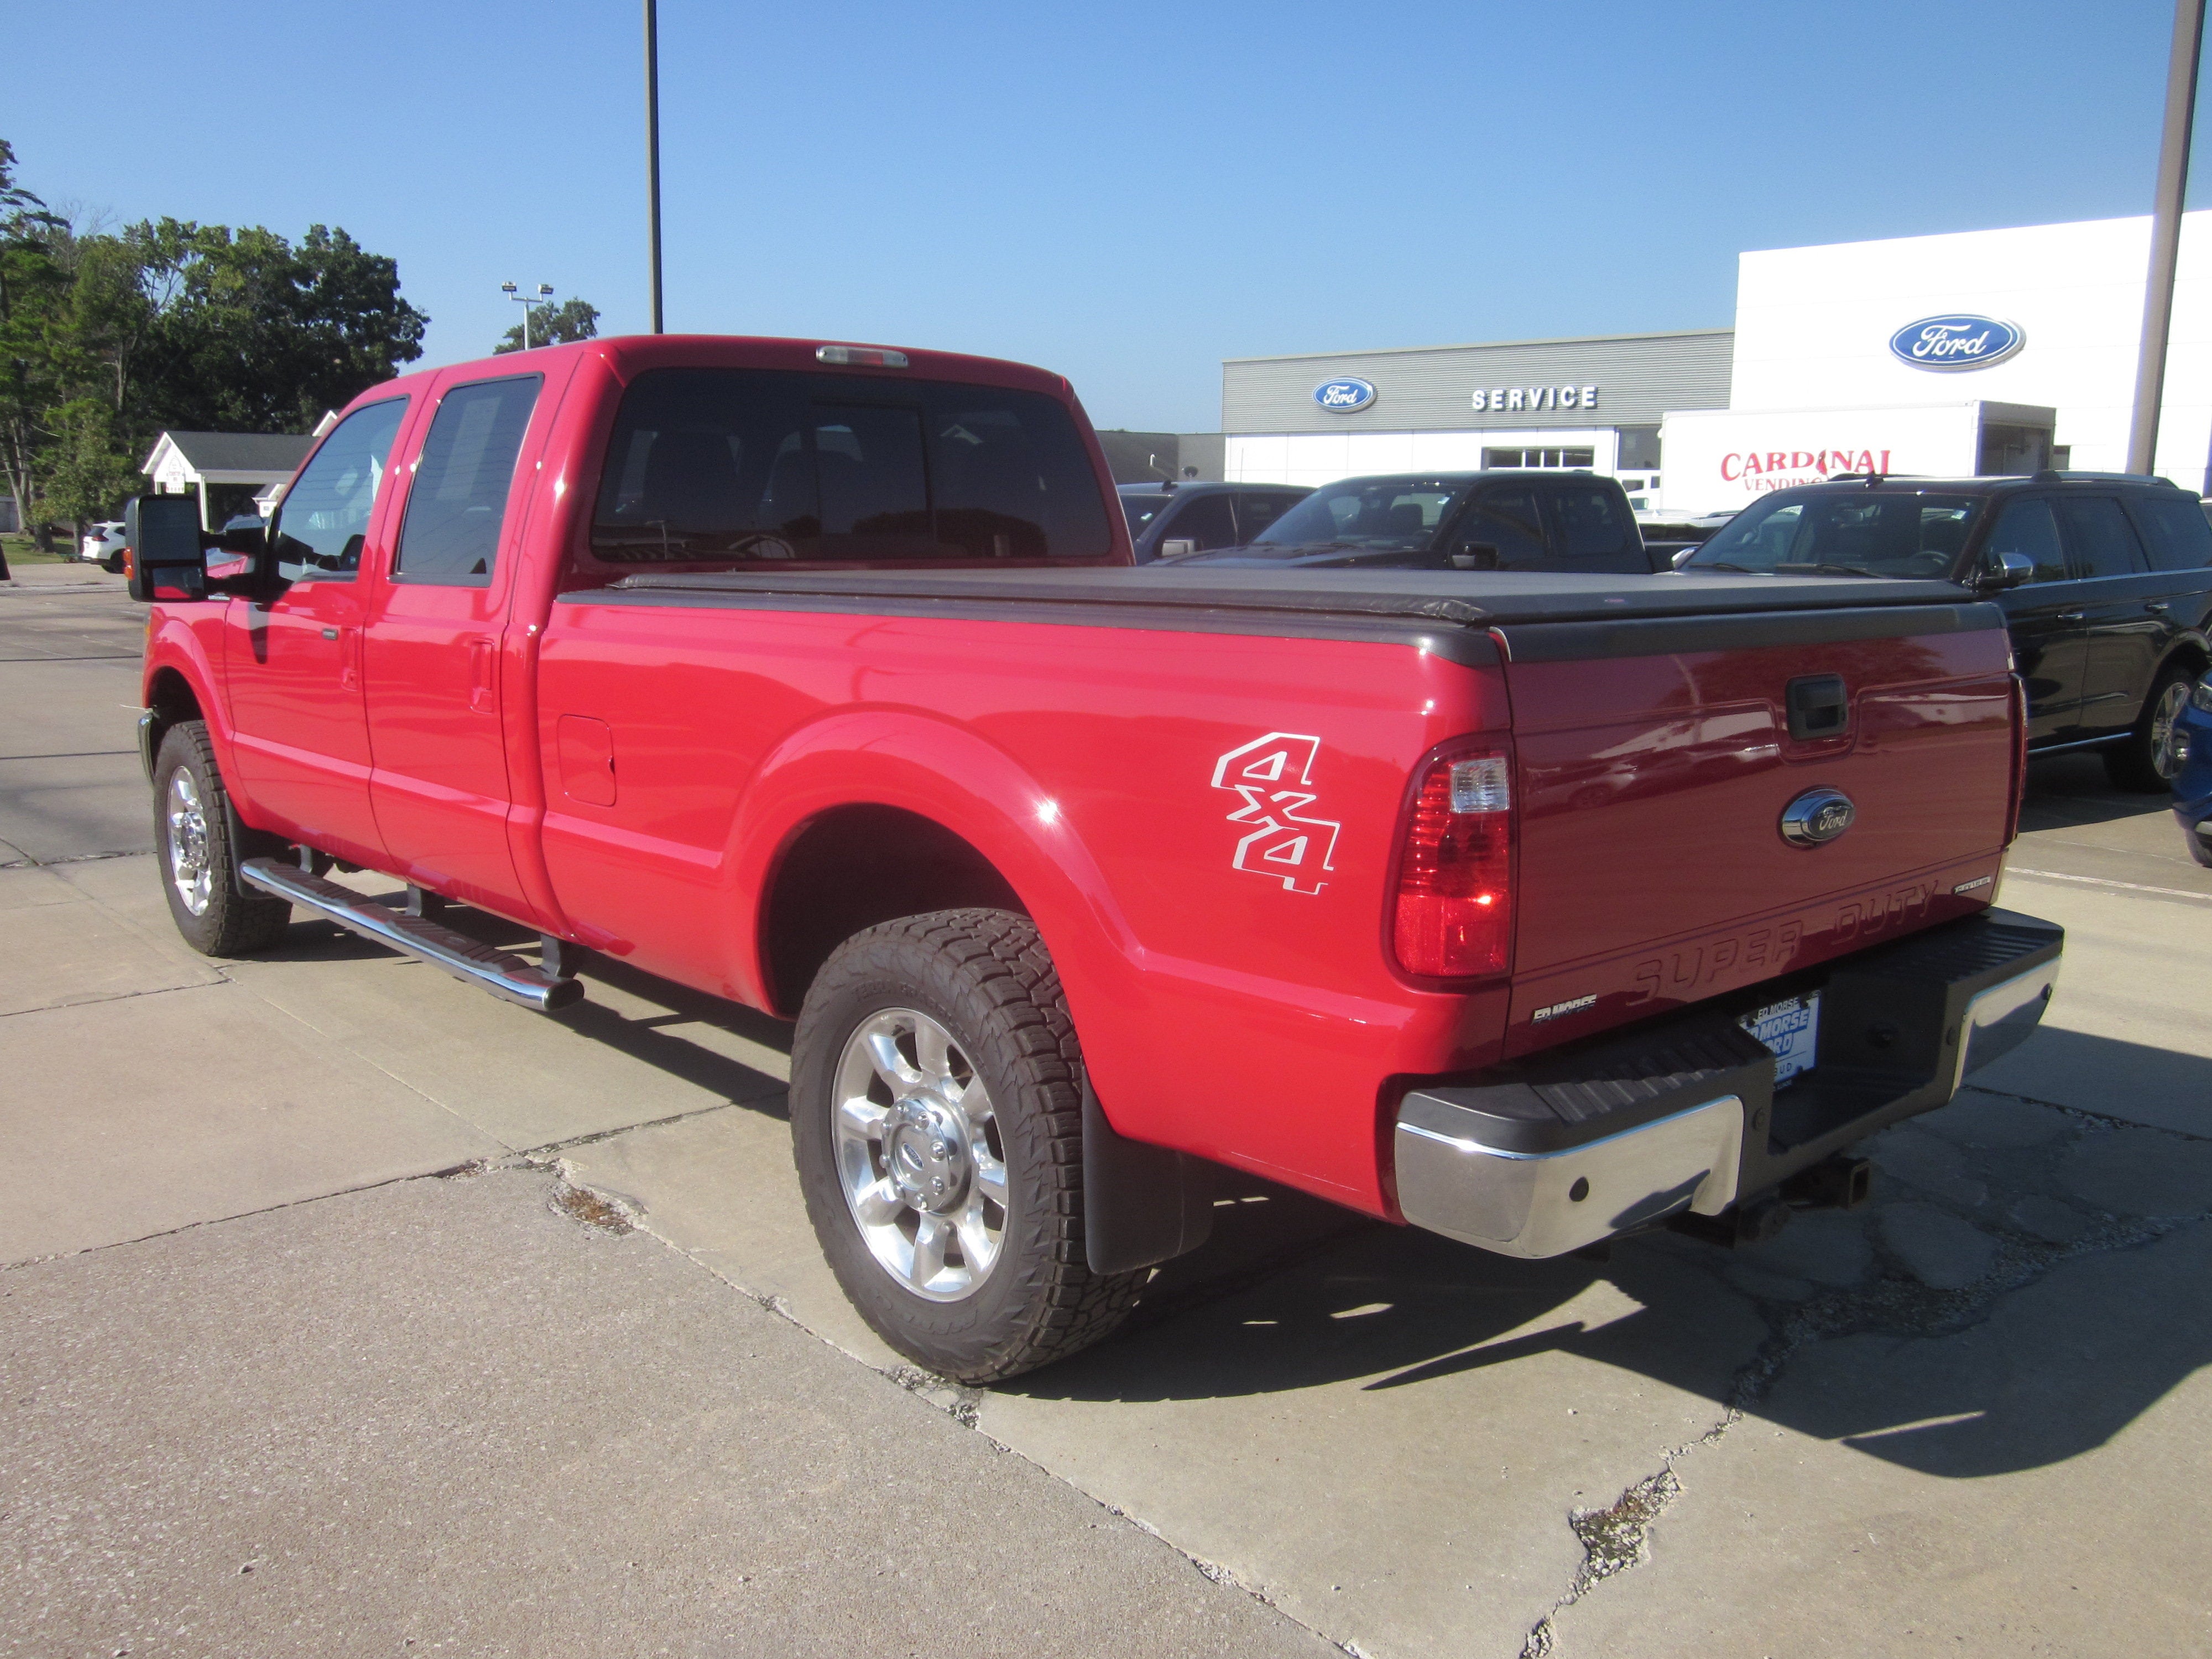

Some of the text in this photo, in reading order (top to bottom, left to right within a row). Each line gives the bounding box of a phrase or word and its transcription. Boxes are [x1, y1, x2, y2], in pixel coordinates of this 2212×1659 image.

[1912, 324, 1990, 357] Ford
[1323, 385, 1358, 404] Ford
[1472, 386, 1597, 410] SERVICE
[1819, 805, 1851, 831] Ford
[1626, 880, 1938, 1006] SUPER DUTY
[1757, 1006, 1768, 1019] ED
[1769, 997, 1799, 1016] MORSE
[1760, 1009, 1809, 1041] MORSE
